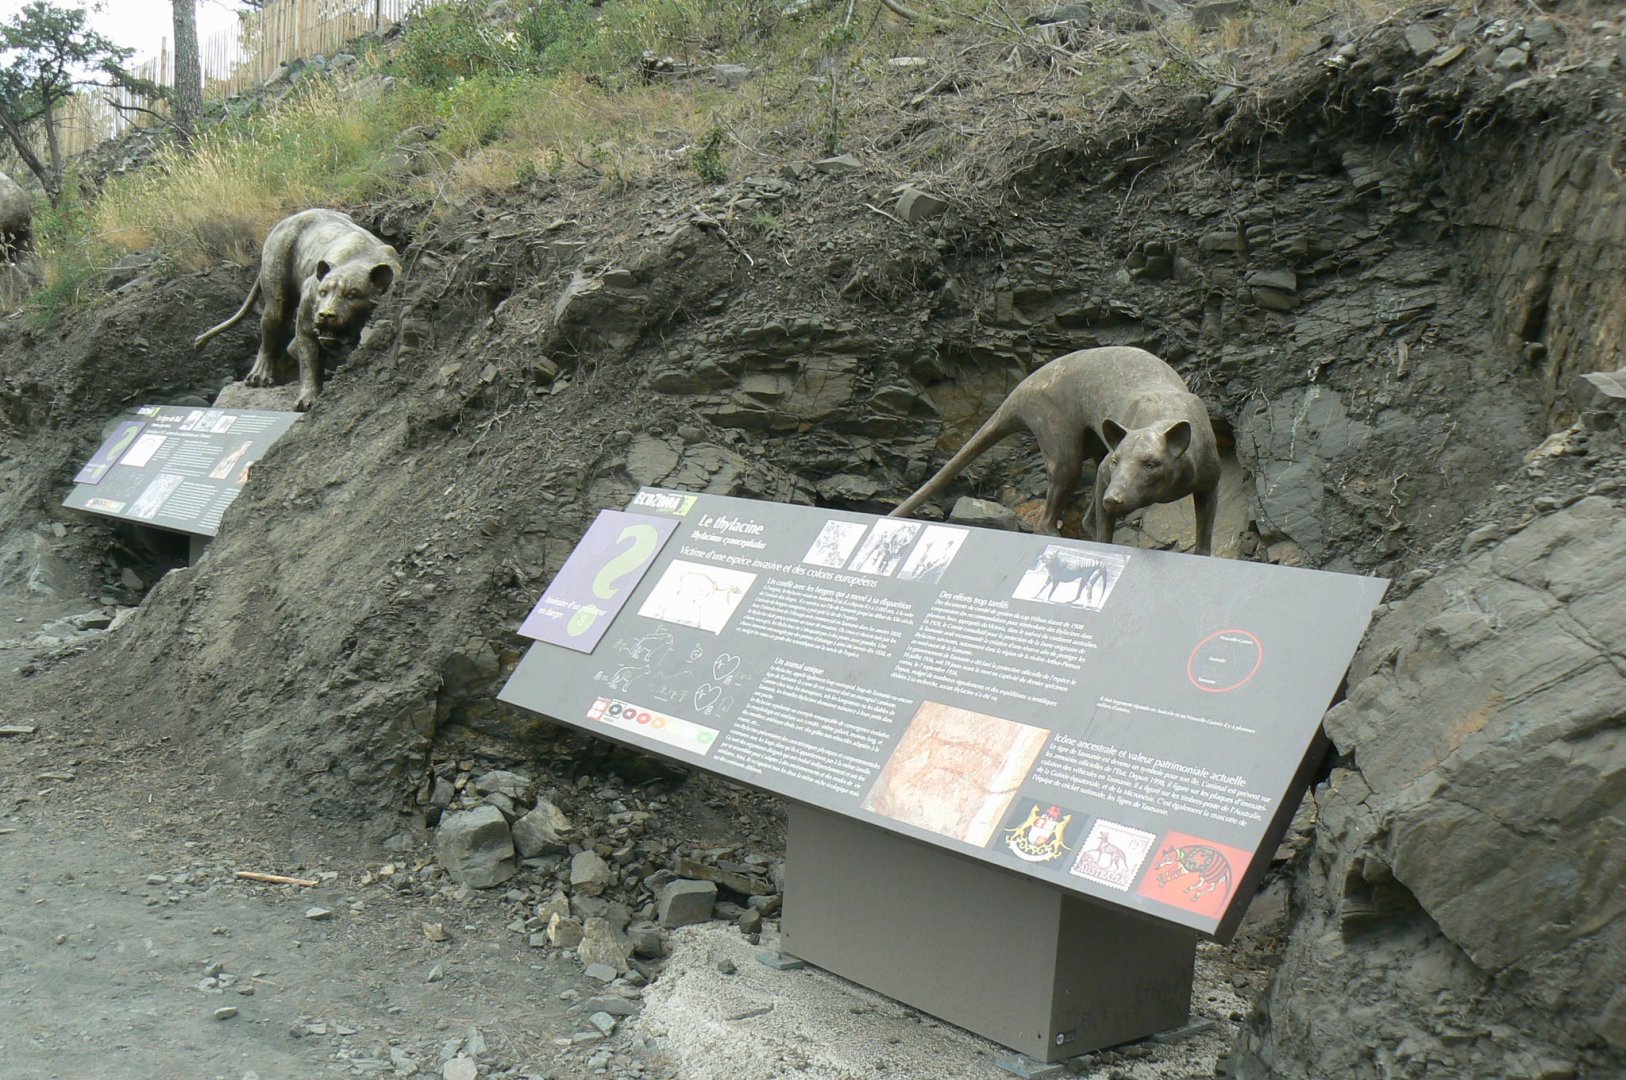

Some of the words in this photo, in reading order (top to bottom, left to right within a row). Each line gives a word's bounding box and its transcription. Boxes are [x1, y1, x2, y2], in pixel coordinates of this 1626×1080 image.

[698, 514, 713, 527] Le
[713, 516, 764, 535] thylacine
[680, 546, 706, 558] Victime
[705, 550, 726, 561] d'une
[726, 555, 752, 566] espèce
[751, 560, 782, 571] invasive
[783, 565, 792, 573] et
[792, 564, 807, 575] des
[806, 568, 834, 580] colons
[834, 574, 878, 587] européens
[939, 591, 952, 599] Des
[952, 593, 973, 603] efforts
[973, 597, 988, 607] trop
[988, 600, 1009, 609] tardifs
[774, 657, 784, 665] Un
[784, 661, 805, 670] animal
[803, 665, 824, 676] unique
[1053, 754, 1077, 763] armoiries
[1078, 760, 1103, 770] officielles
[1128, 771, 1149, 782] Depuis
[1150, 777, 1165, 787] 1998,
[1172, 783, 1189, 792] figure
[1200, 789, 1209, 797] les
[1208, 792, 1233, 803] plaques
[1054, 733, 1076, 745] Icône
[1077, 741, 1117, 755] ancestrale
[1128, 753, 1154, 764] valeur
[1153, 760, 1209, 778] patrimoniale
[1210, 773, 1246, 787] actuelle
[1077, 749, 1102, 761] Tasmanie
[1110, 758, 1131, 768] devenu
[1140, 767, 1164, 776] symbole
[1201, 780, 1228, 792] L'animal
[1236, 791, 1260, 800] présent
[1041, 760, 1062, 768] culation
[1073, 767, 1097, 778] véhicules
[1106, 775, 1132, 787] Tasmanie.
[1143, 785, 1161, 794] figuré
[1171, 791, 1180, 799] les
[1180, 795, 1220, 810] timbres-poste
[1050, 770, 1070, 780] Guinée
[1070, 775, 1100, 788] équatoriale,
[1123, 789, 1154, 802] Micronésie.
[1157, 798, 1172, 806] C'est
[1172, 802, 1203, 815] également
[1210, 813, 1238, 824] mascotte
[1079, 865, 1127, 884] AUSTRALIA
